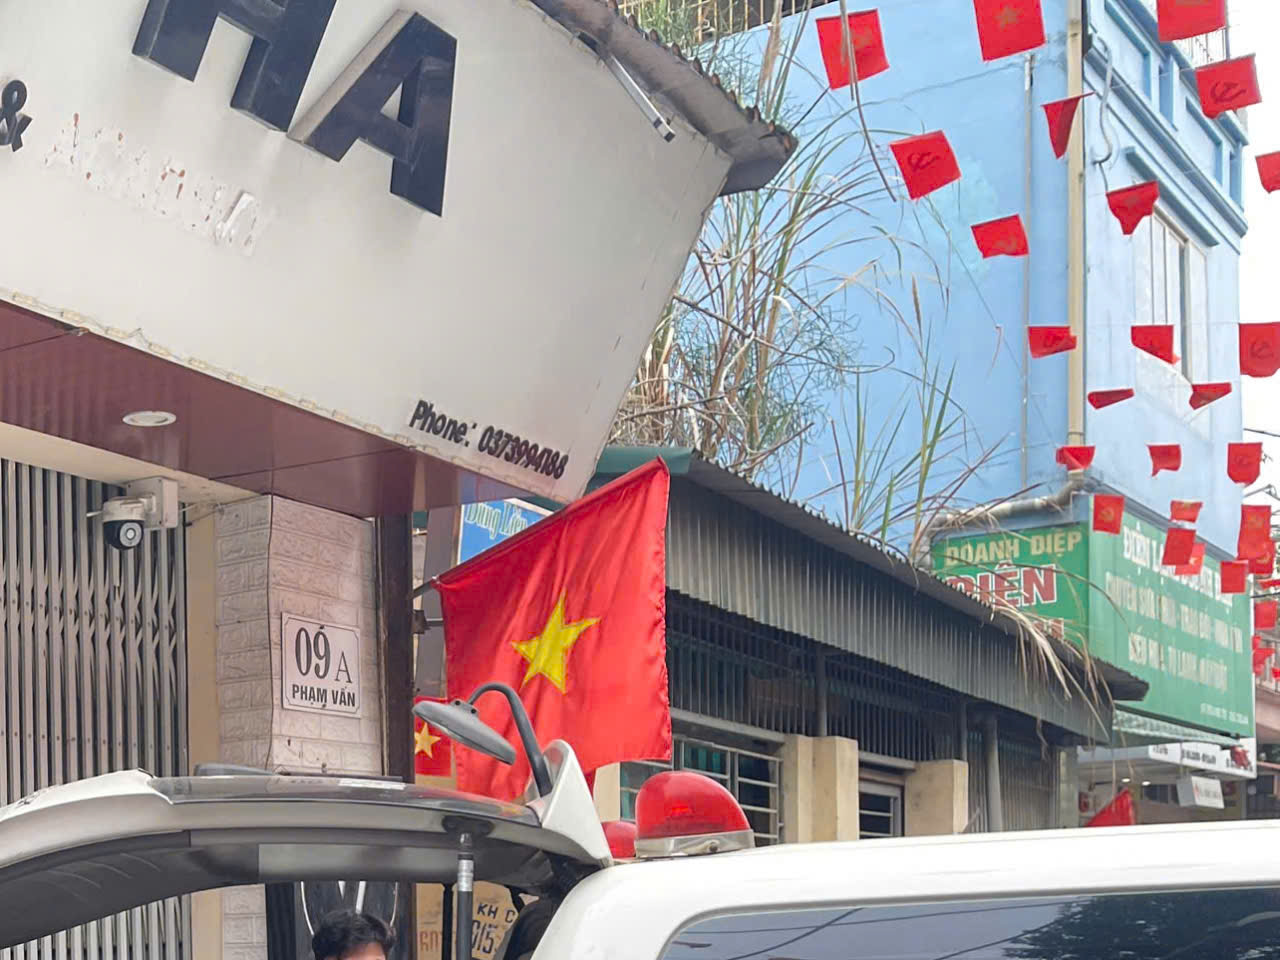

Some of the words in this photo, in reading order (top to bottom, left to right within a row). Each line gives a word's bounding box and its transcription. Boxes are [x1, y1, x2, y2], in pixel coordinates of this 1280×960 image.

[409, 400, 477, 447] Phone:
[946, 538, 1019, 566] DOANH
[295, 627, 331, 679] 09
[334, 651, 352, 683] A
[292, 684, 327, 705] PHẠM
